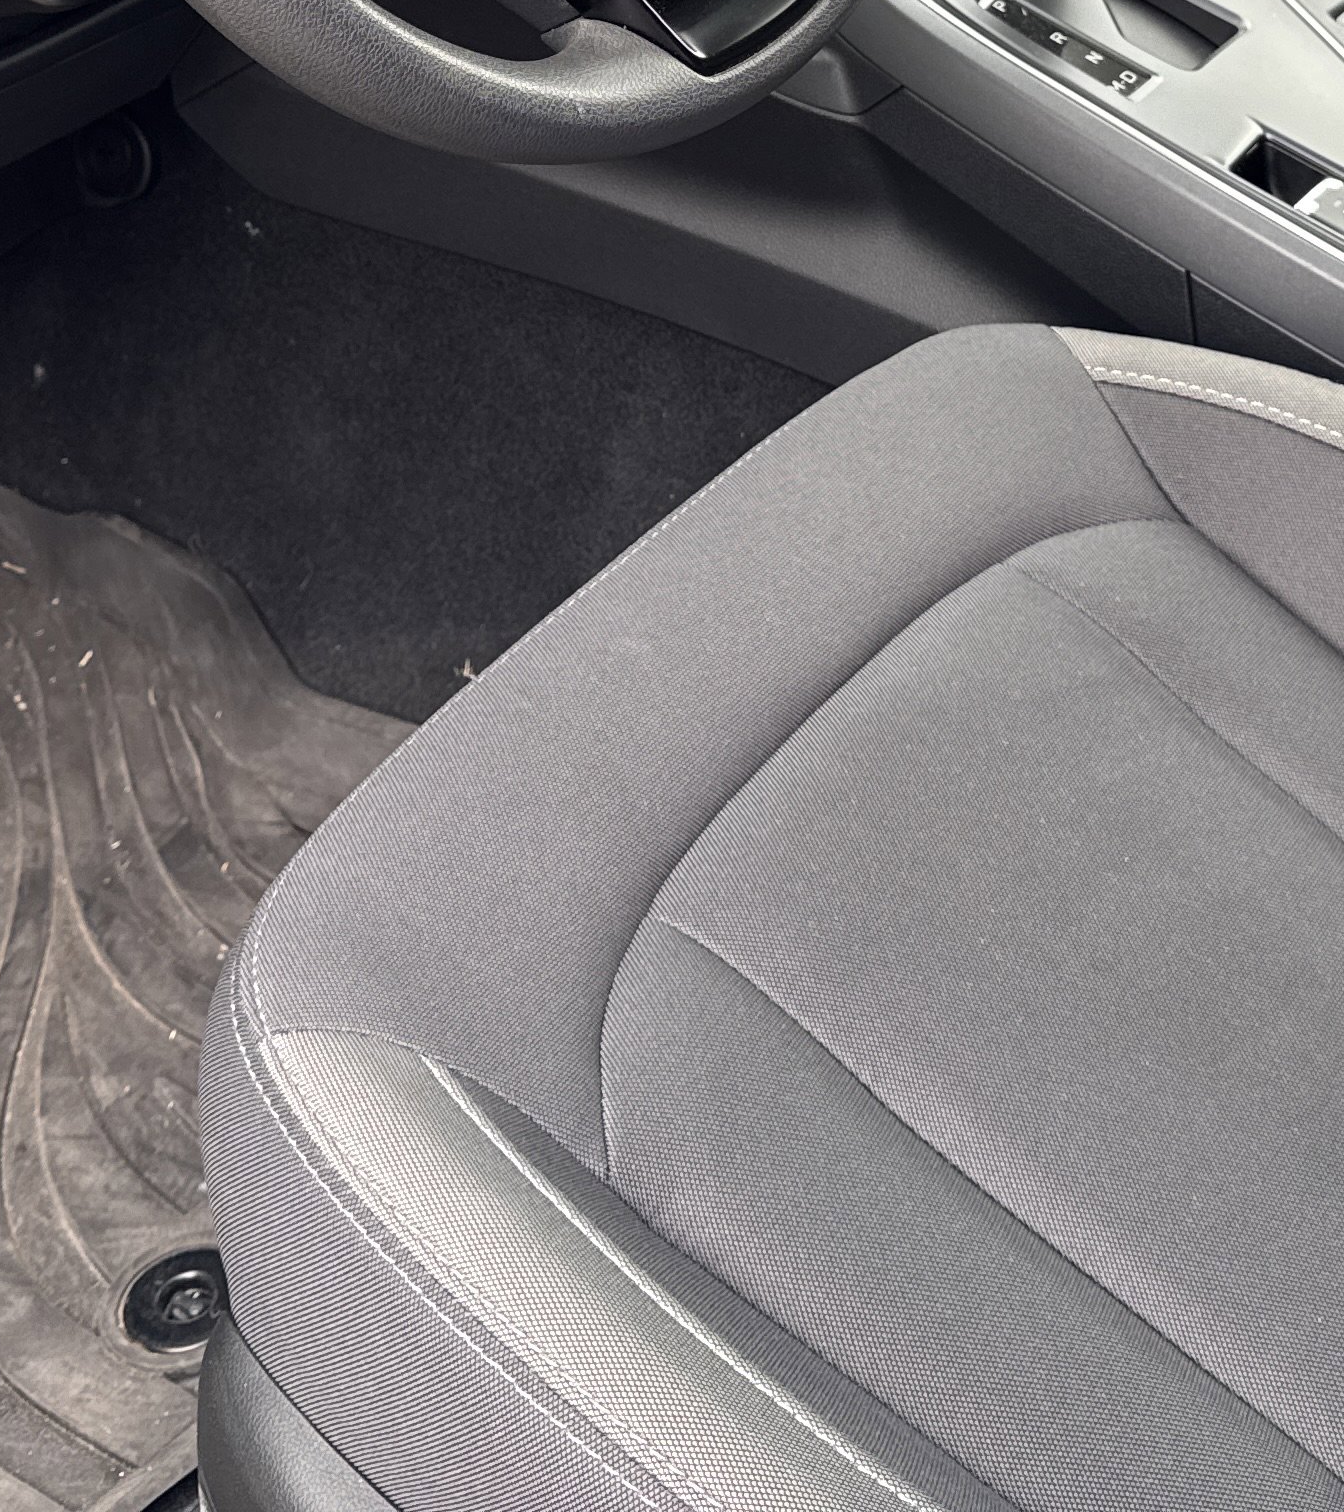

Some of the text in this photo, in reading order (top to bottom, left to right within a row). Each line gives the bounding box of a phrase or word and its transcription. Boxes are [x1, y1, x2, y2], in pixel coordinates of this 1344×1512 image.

[992, 0, 1006, 13] P
[1049, 31, 1068, 45] R
[1084, 50, 1104, 65] N
